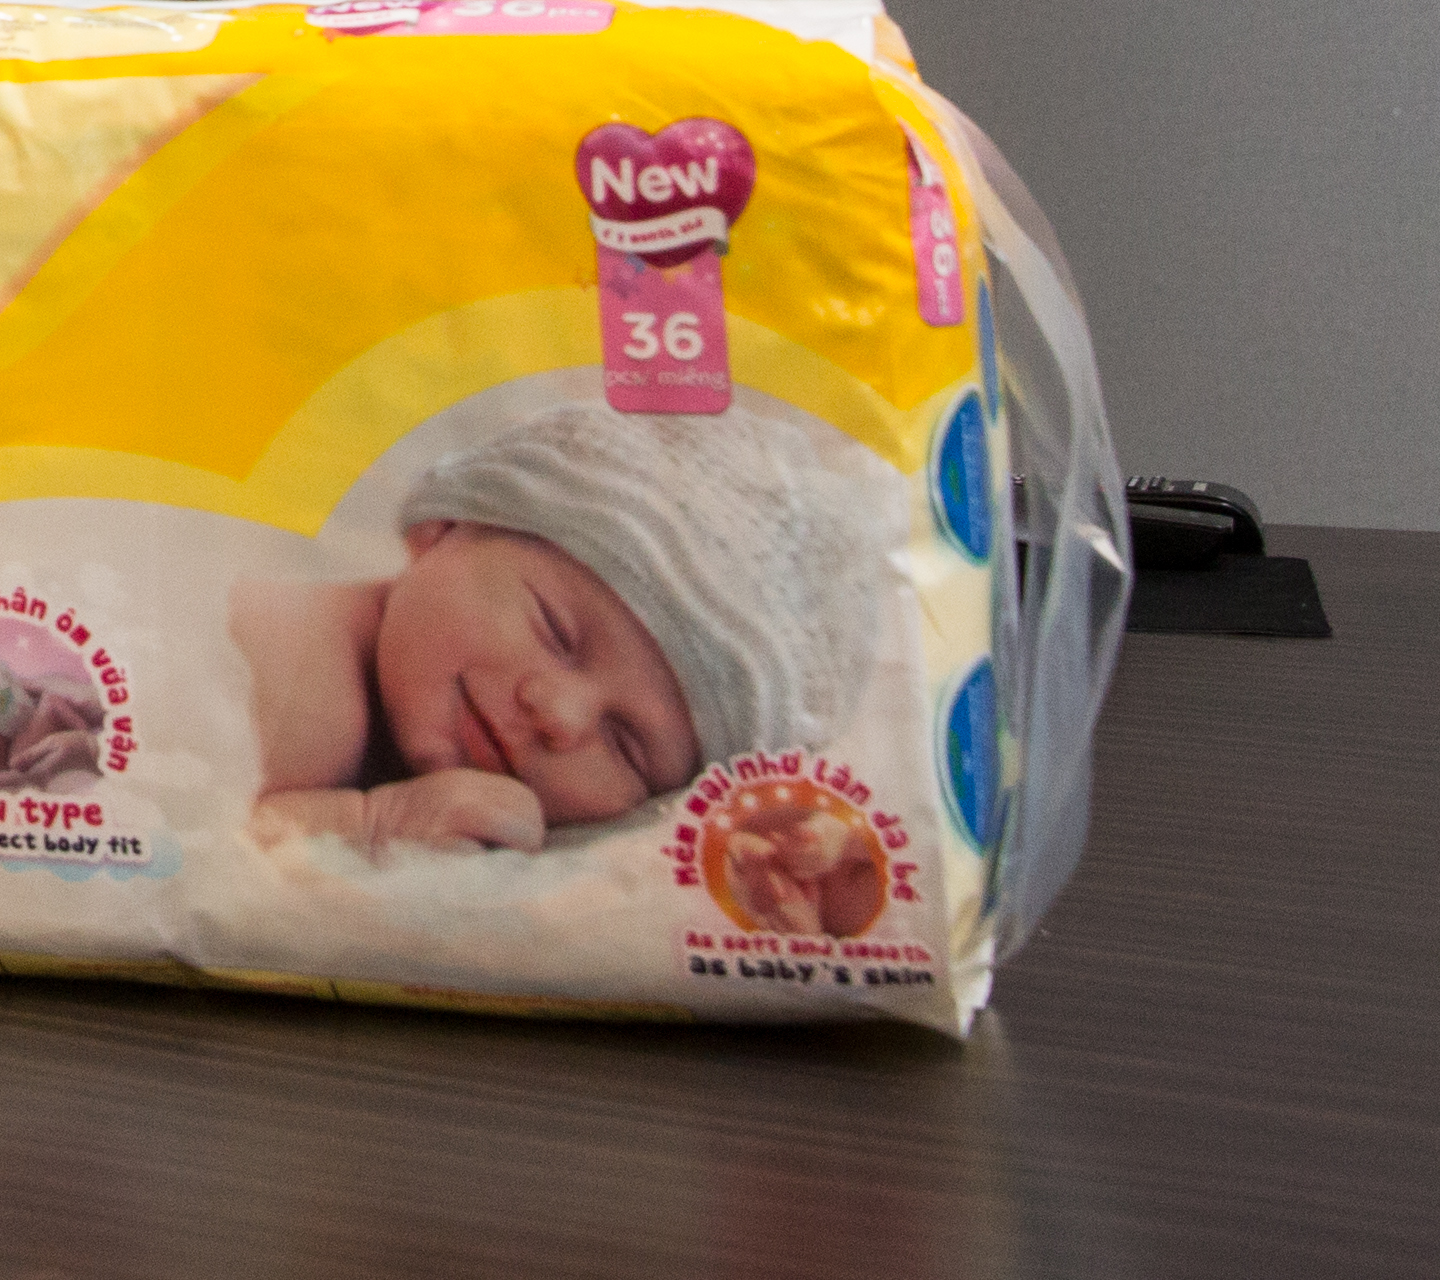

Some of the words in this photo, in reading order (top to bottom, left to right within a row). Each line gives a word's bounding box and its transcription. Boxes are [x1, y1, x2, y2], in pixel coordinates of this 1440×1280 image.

[589, 156, 719, 205] New
[621, 310, 705, 361] 36
[19, 795, 104, 831] type
[42, 831, 100, 856] body
[105, 834, 143, 857] fit
